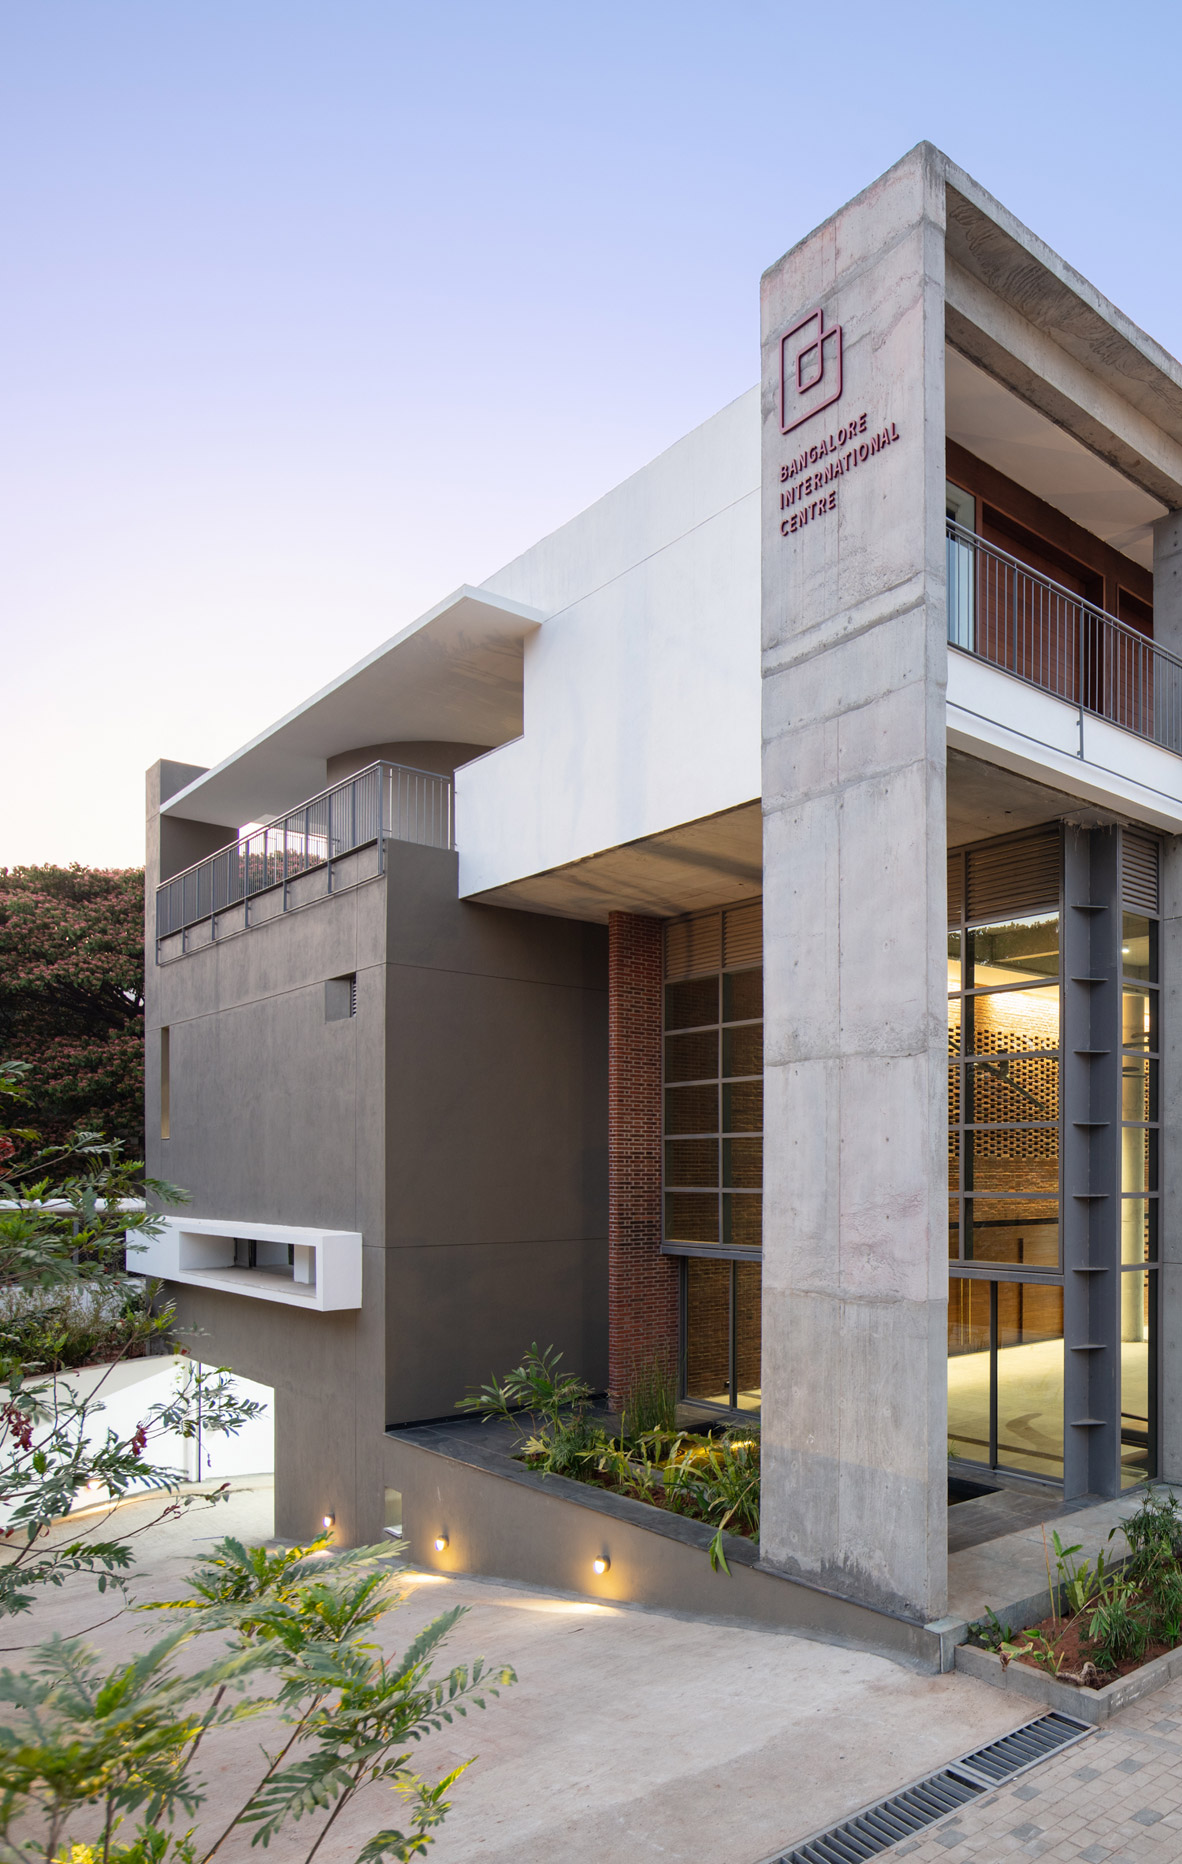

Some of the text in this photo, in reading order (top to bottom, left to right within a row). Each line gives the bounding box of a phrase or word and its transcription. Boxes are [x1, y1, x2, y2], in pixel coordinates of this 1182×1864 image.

[779, 412, 867, 482] BANGALORE
[779, 422, 899, 510] INTERNATIONAL
[779, 491, 837, 537] CENTRE
